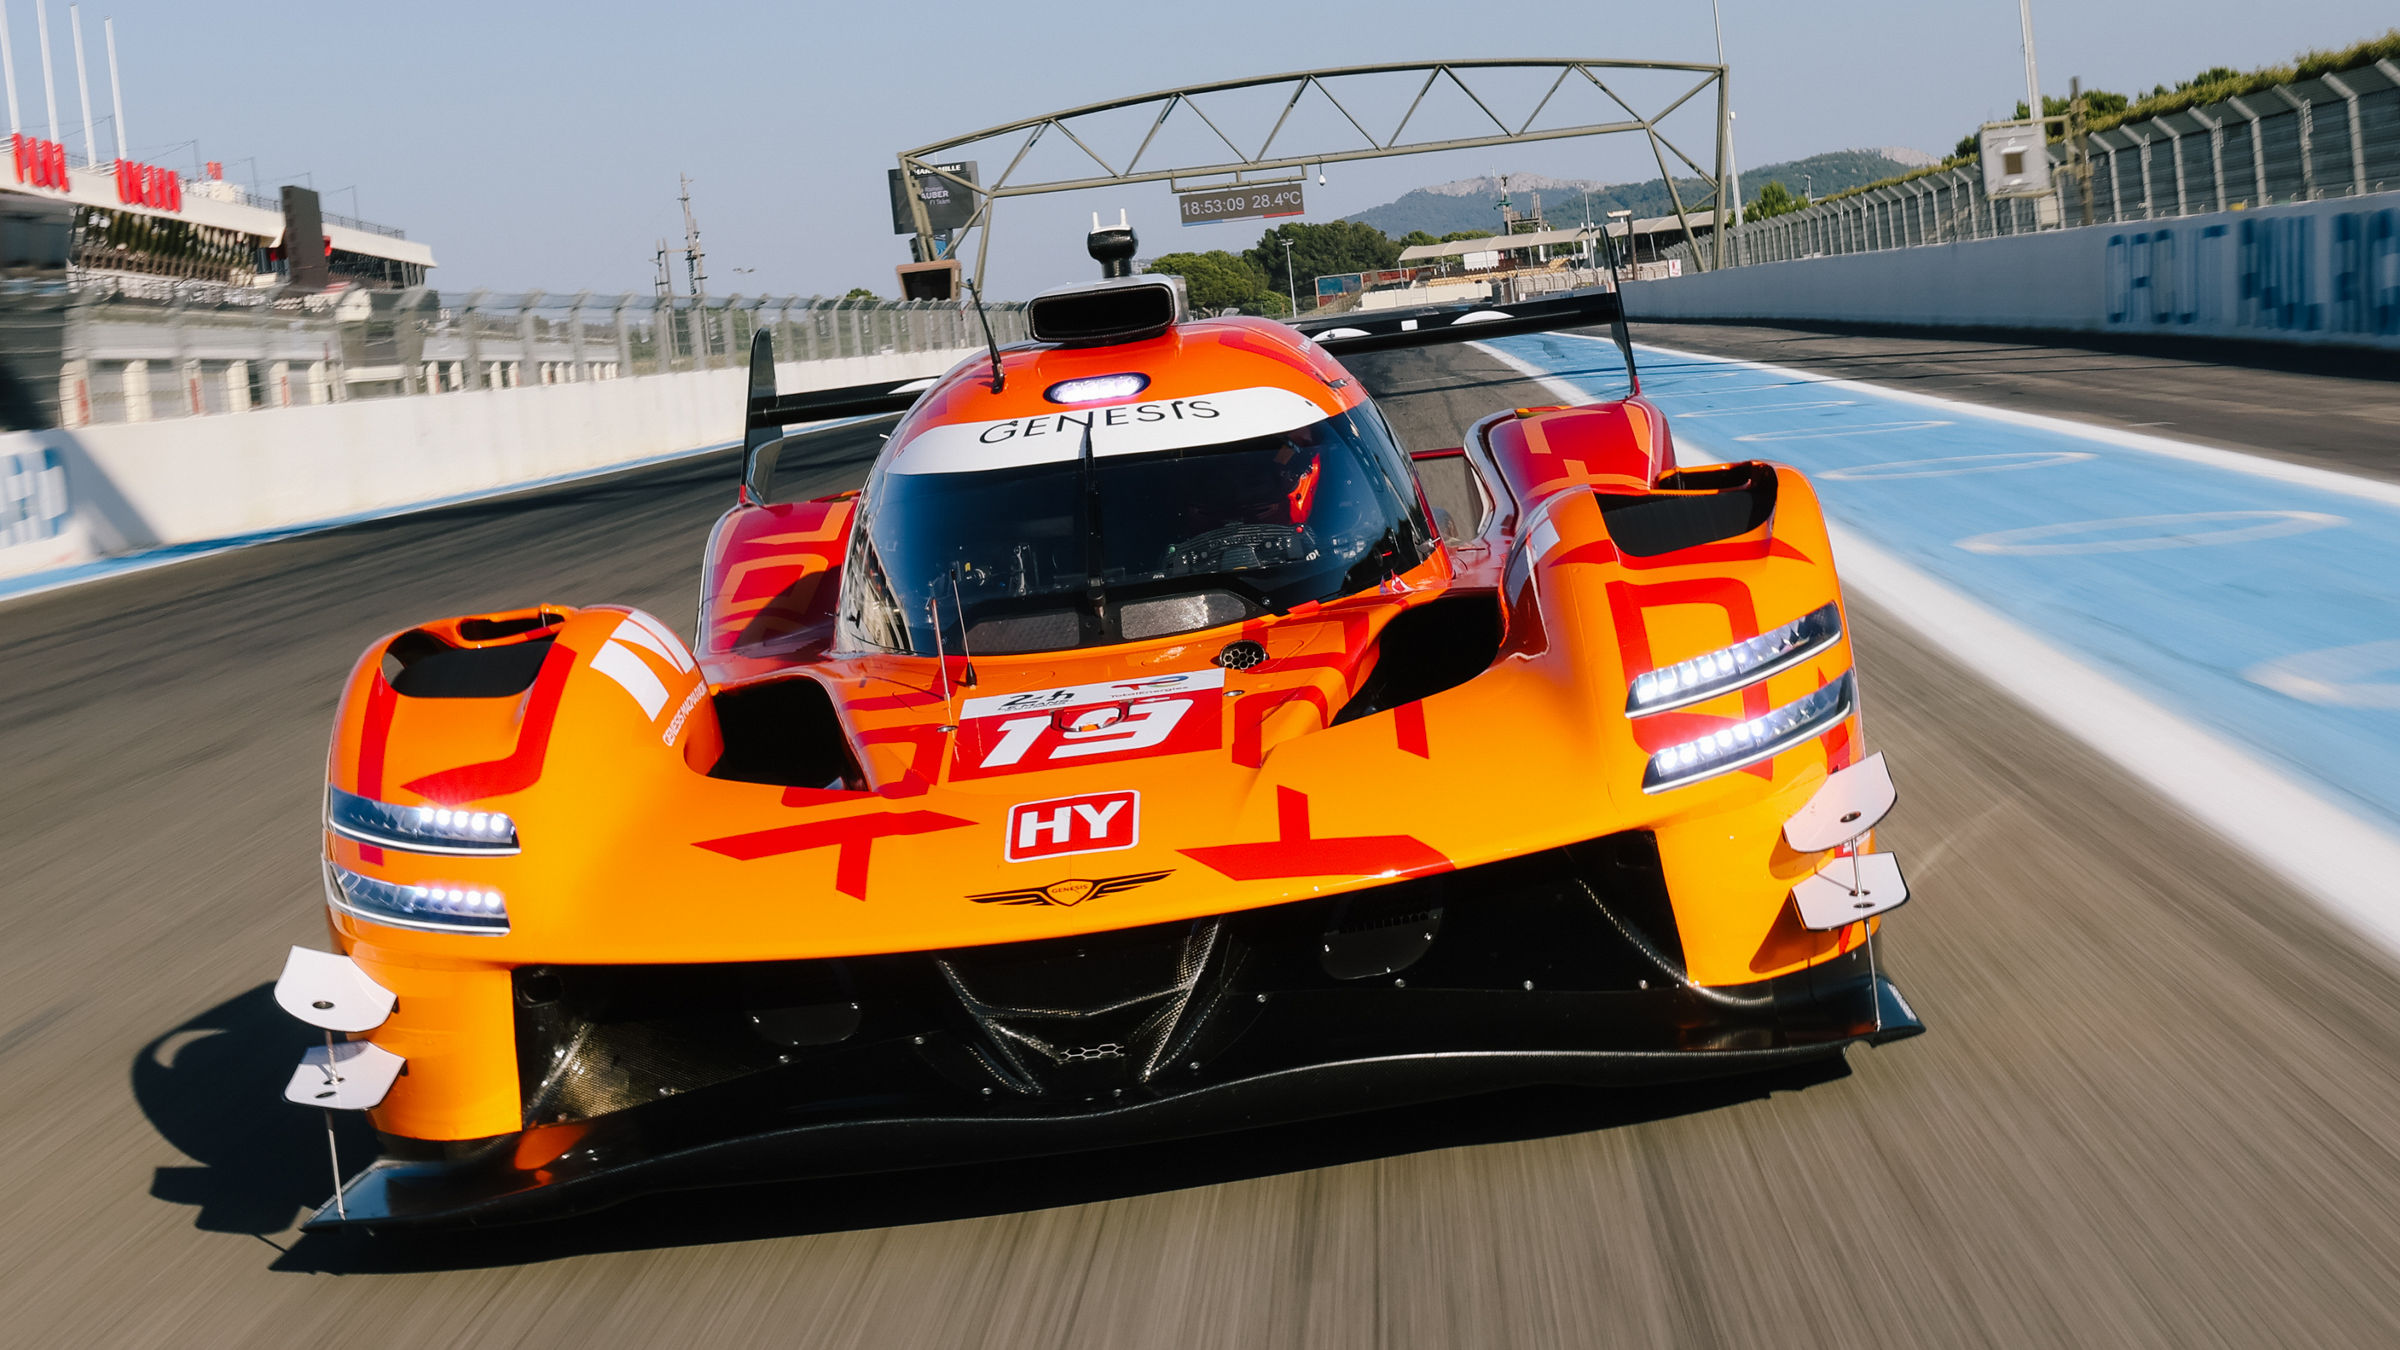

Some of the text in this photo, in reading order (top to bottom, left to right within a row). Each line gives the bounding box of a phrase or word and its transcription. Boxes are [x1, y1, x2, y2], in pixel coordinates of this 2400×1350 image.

[921, 190, 949, 200] AUBER
[1182, 197, 1245, 215] 18:53:09
[979, 399, 1220, 444] GENESIS
[979, 698, 1195, 769] 19
[1018, 799, 1128, 849] HY
[1051, 883, 1089, 893] GENESIS
